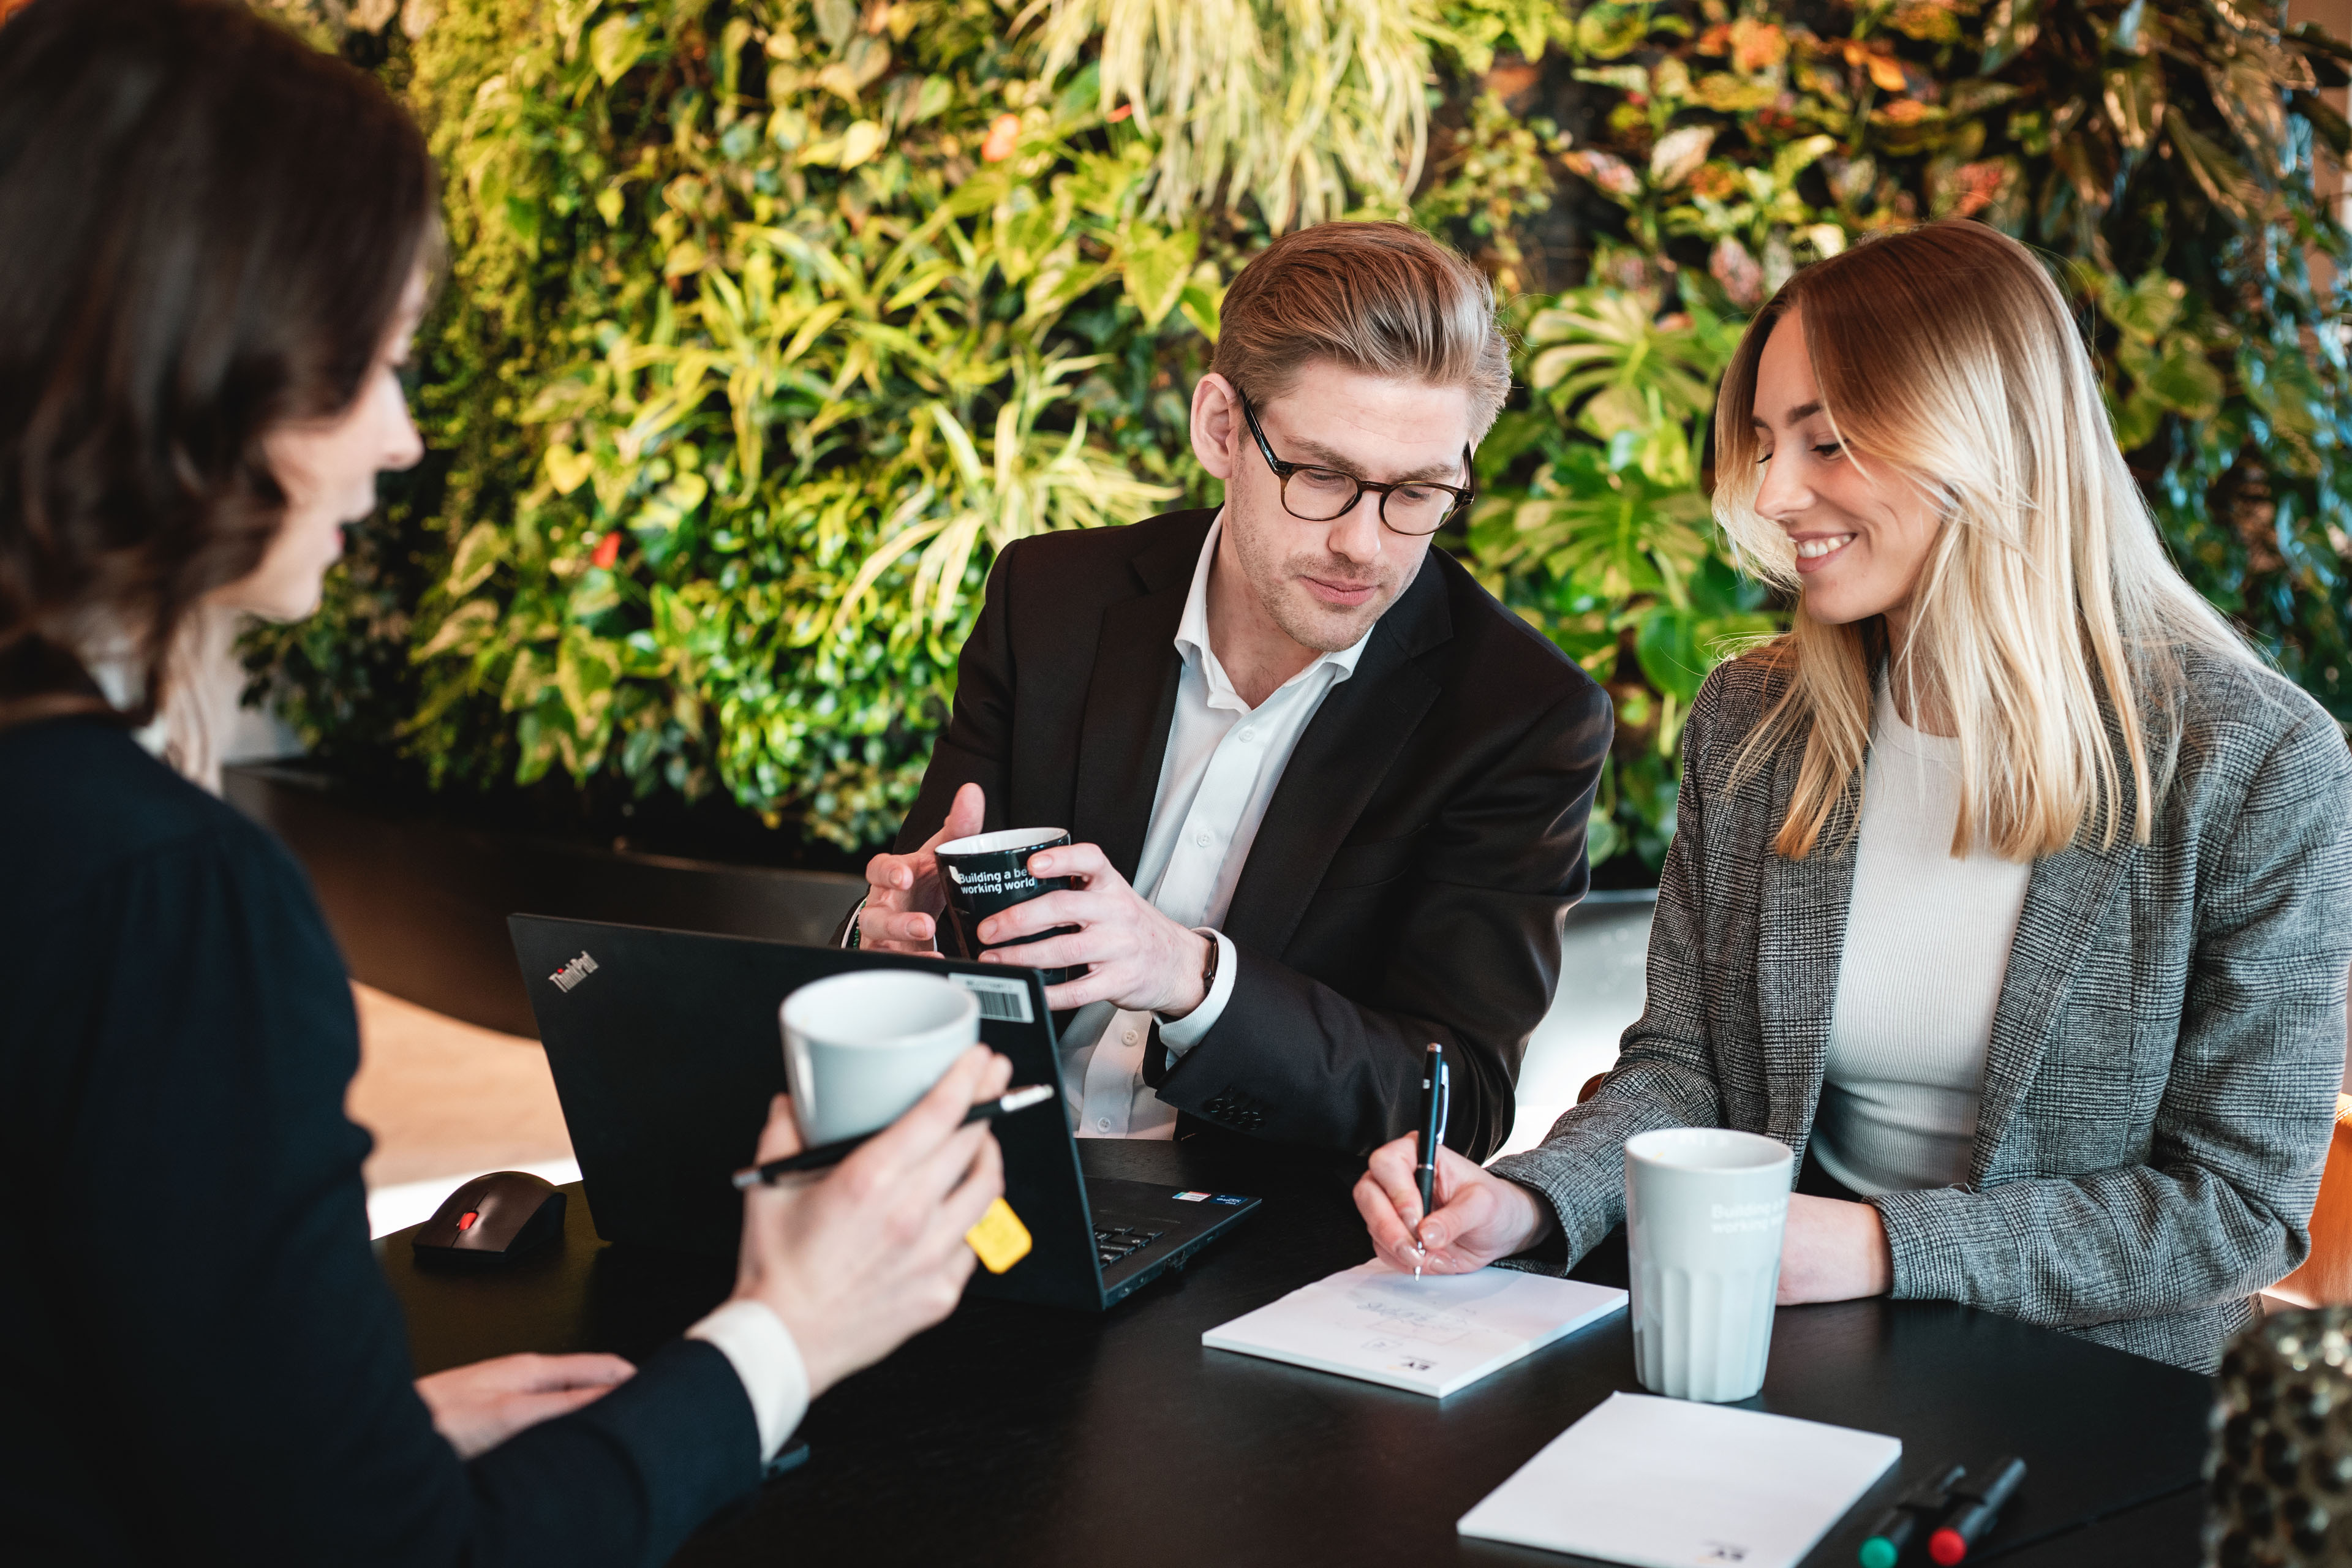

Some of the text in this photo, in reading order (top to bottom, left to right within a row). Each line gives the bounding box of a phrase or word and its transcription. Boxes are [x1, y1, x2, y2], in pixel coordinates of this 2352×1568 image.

[959, 872, 1001, 883] Building
[960, 876, 1035, 894] working world
[548, 950, 600, 993] ThinkPad
[1711, 1200, 1771, 1219] Building
